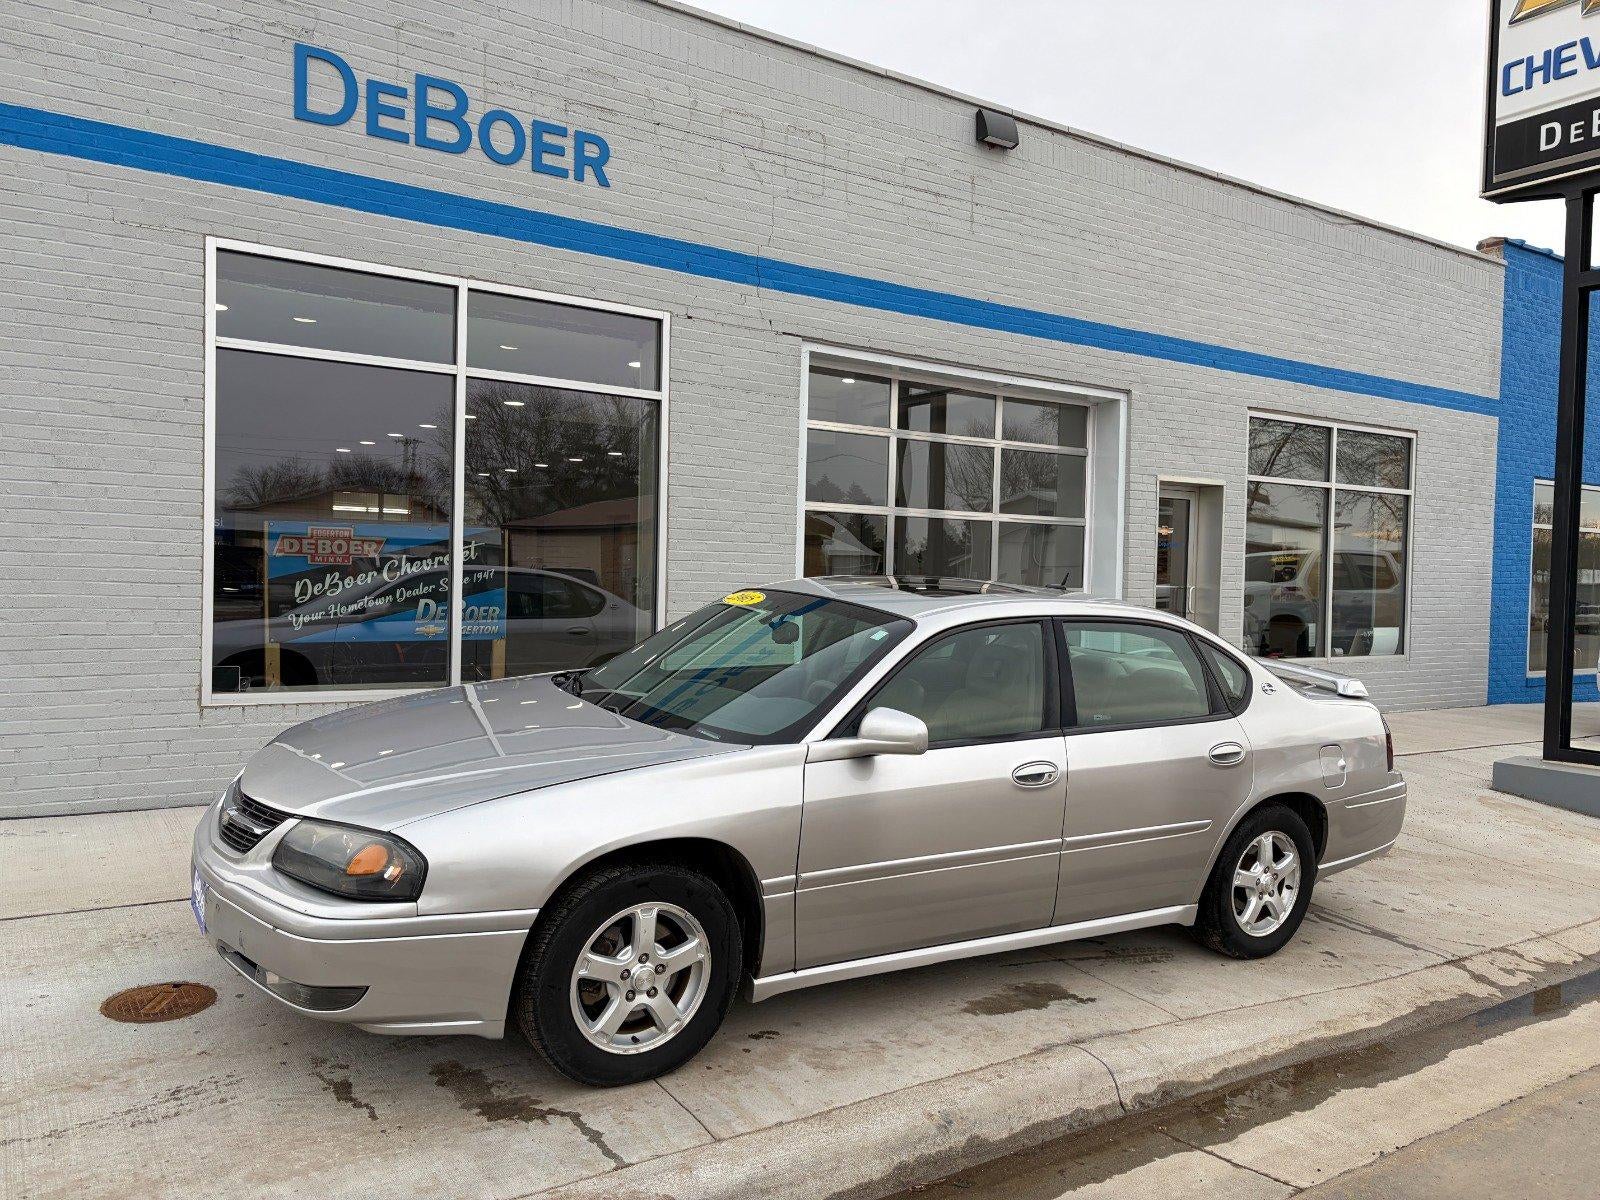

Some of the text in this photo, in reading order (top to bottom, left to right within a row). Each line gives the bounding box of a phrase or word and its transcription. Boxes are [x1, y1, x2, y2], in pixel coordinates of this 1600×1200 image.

[283, 538, 379, 556] DEBOER
[313, 528, 350, 538] EDGERTON
[294, 540, 486, 603] DeBoer Chevroet
[287, 612, 326, 630] Your
[327, 595, 394, 619] Hometown
[396, 582, 436, 603] Dealer
[473, 568, 495, 583] 1947
